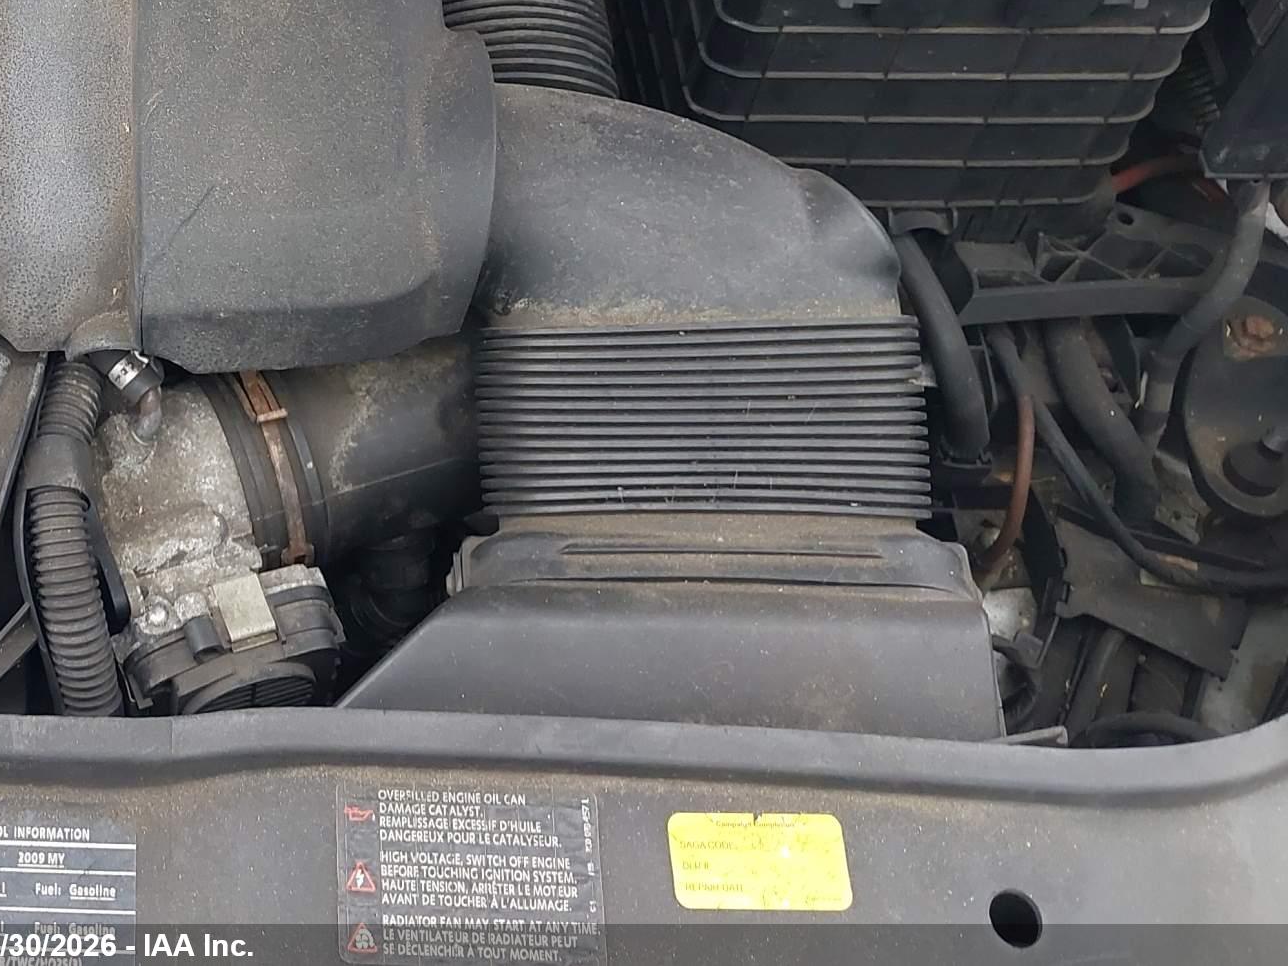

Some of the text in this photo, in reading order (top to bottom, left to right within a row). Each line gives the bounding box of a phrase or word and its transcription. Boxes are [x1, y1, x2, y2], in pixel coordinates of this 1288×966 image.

[442, 792, 481, 804] ENGINE
[483, 793, 501, 804] OIL
[504, 794, 526, 805] CAN
[379, 803, 426, 815] DAMAGE
[14, 826, 90, 841] INFORMATION
[452, 818, 497, 831] EXCESSIF
[499, 820, 541, 833] D'HUILE
[380, 829, 562, 848] DANGEREUX POUR LE CATALYSEUR.
[18, 852, 65, 865] 2009 MY
[380, 851, 408, 864] HIGH
[466, 854, 506, 867] SWITCH
[509, 856, 529, 868] OFF
[532, 857, 570, 869] ENGINE
[381, 864, 577, 884] BEFORE TOUCHING IGNITION SYSTEM.
[69, 884, 116, 897] Gasoline
[382, 879, 416, 892] HAUTE
[518, 883, 530, 896] LE
[533, 884, 578, 898] MOTEUR
[381, 893, 418, 906] AVANT
[422, 894, 435, 906] DE
[438, 894, 487, 908] TOUCHER
[501, 897, 572, 912] L'ALLUMAGE.
[383, 914, 600, 935] RADIATOR FAN MAY START AT ANY TIME.
[384, 929, 578, 948] LE VENTILATEUR DE RADIATEUR PEUT
[383, 943, 394, 955] SE
[477, 947, 506, 960] TOUT
[510, 948, 562, 962] MOMENT.
